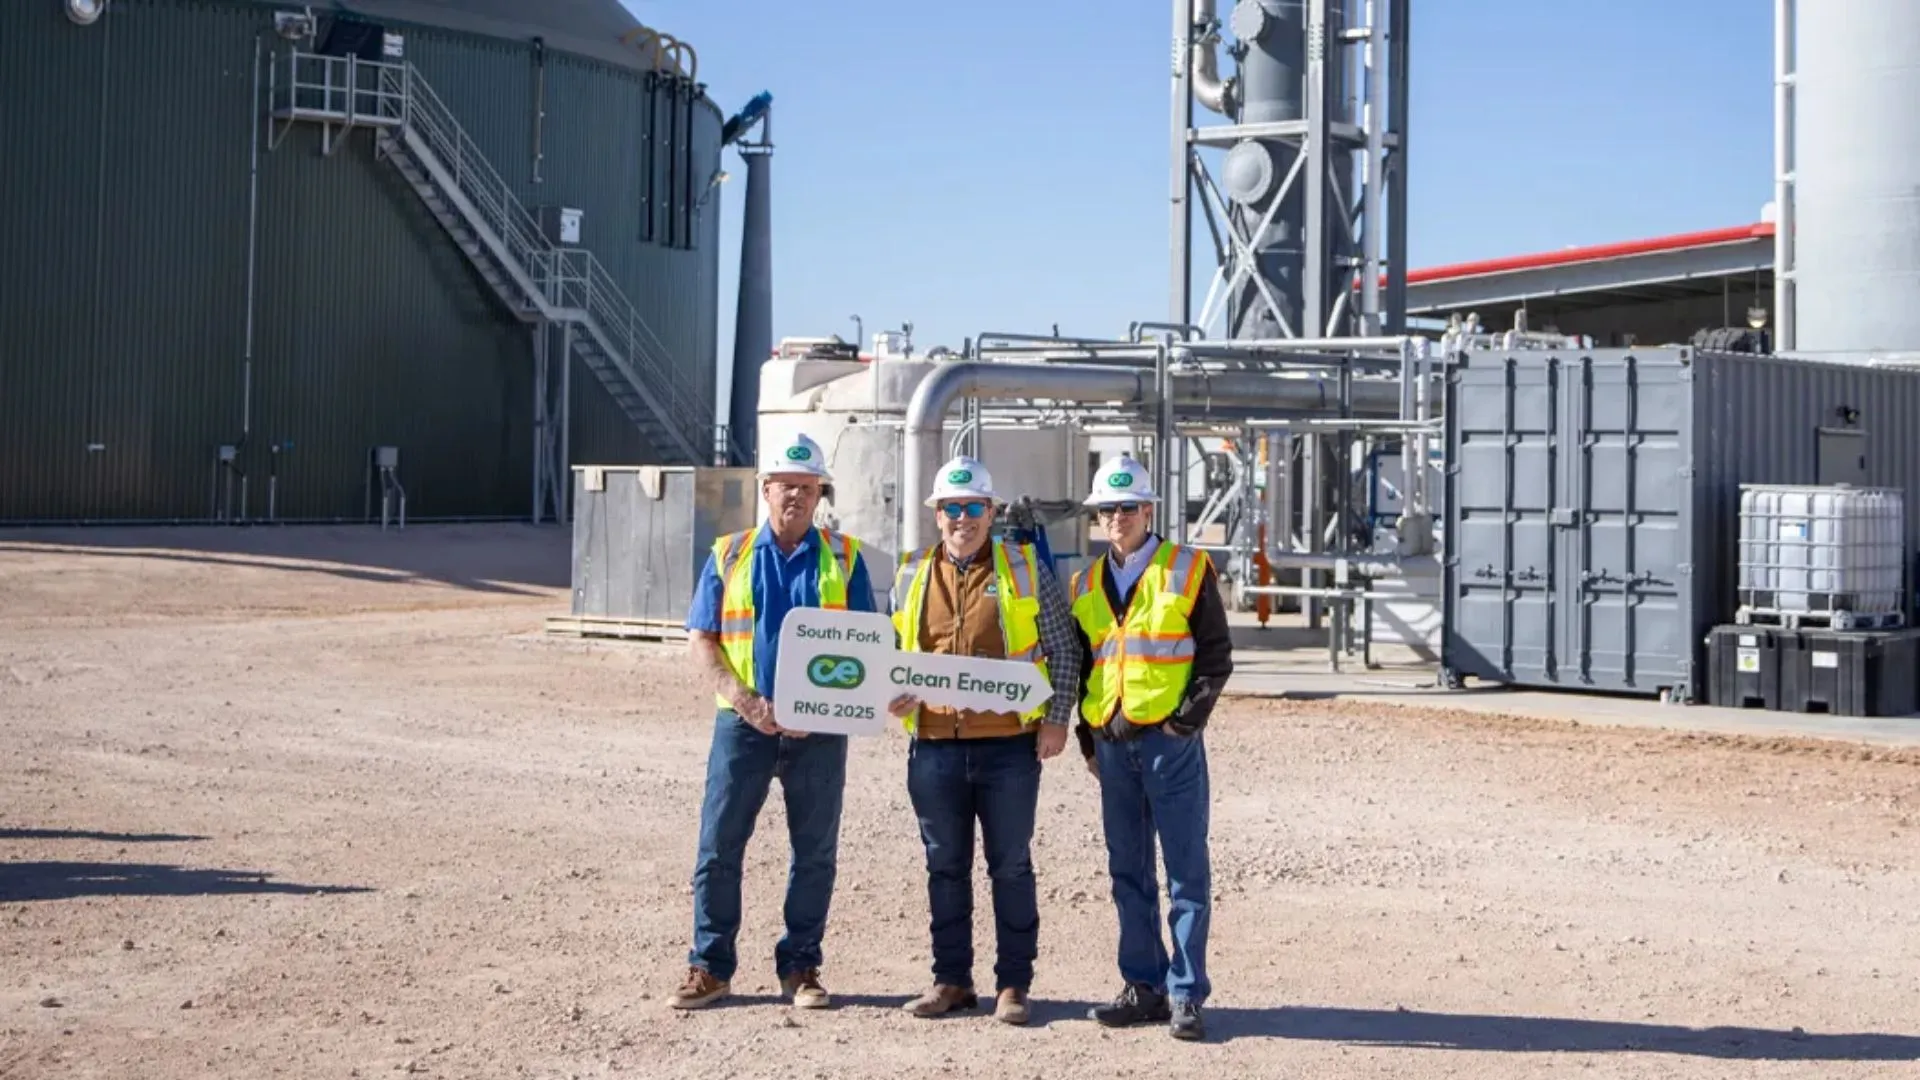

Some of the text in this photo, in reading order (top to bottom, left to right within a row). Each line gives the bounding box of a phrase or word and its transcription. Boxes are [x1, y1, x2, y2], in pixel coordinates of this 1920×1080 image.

[796, 624, 881, 644] South Fork
[889, 666, 1032, 702] Clean Energy
[793, 701, 875, 719] RNG 2025
